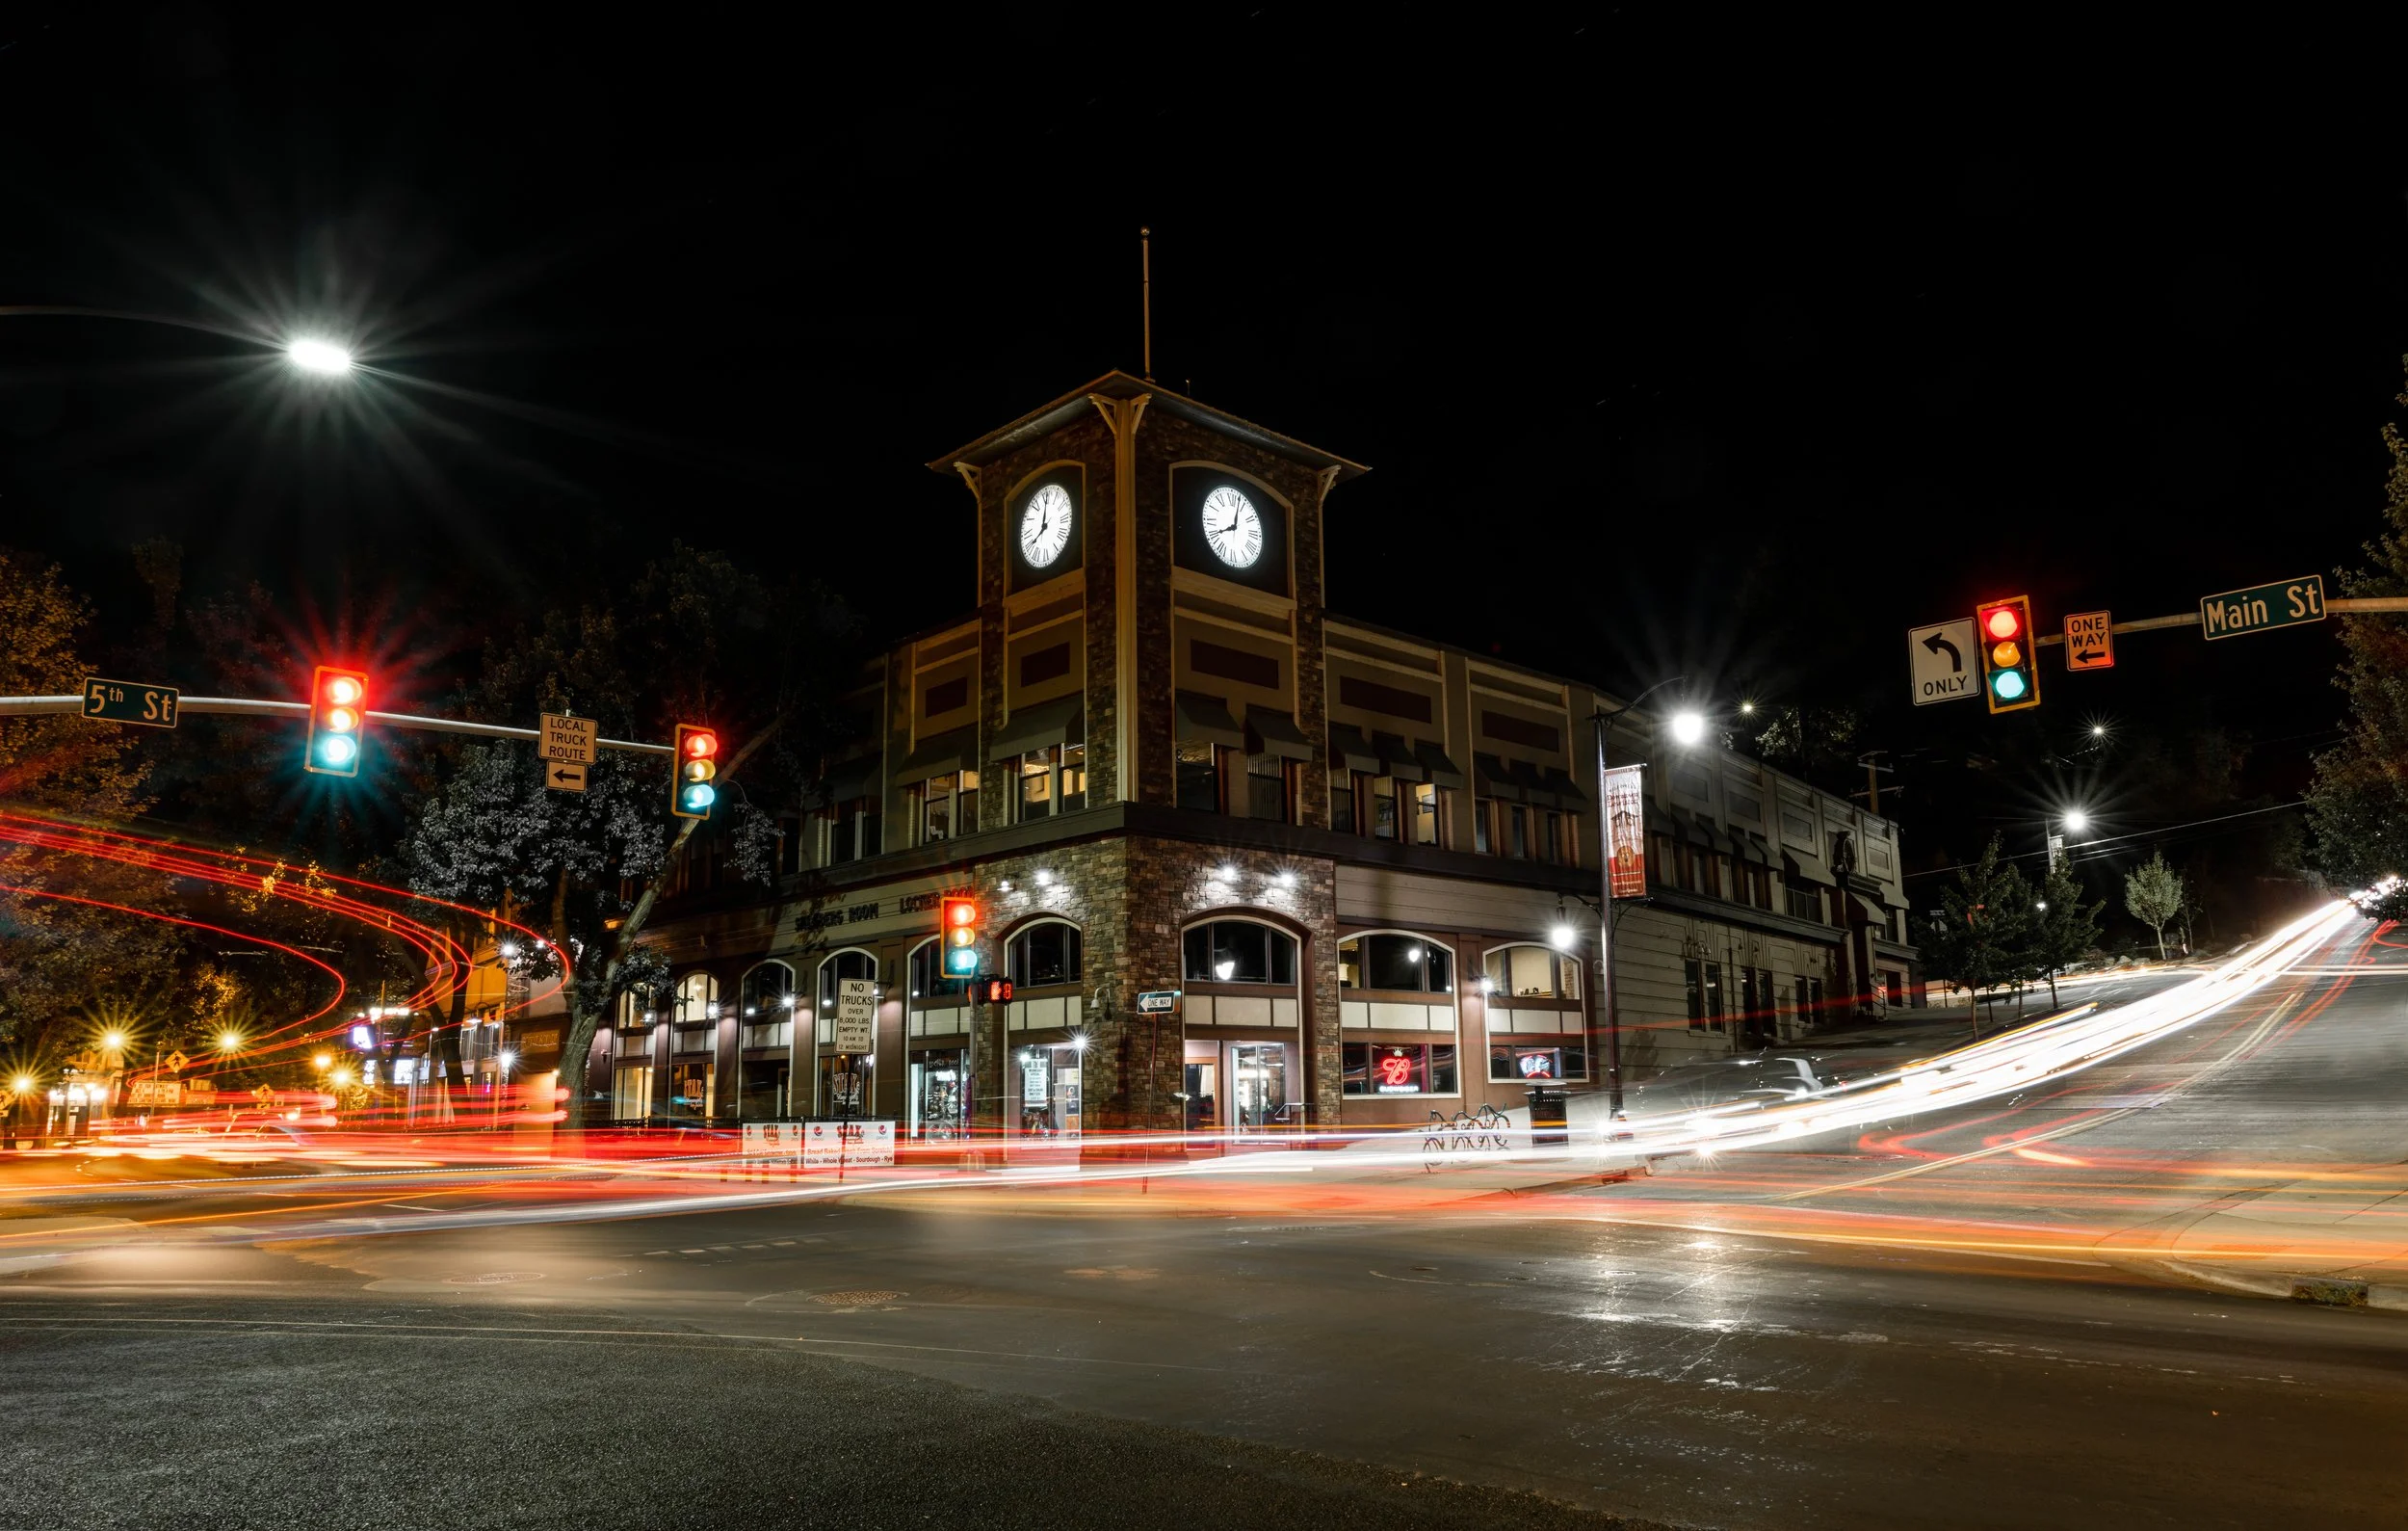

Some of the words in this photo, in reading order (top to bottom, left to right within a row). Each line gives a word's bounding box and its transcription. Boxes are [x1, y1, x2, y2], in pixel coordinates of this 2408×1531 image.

[2207, 595, 2268, 634] Main
[2287, 584, 2320, 619] St
[2071, 616, 2105, 634] ONE
[2072, 631, 2107, 649] WAY
[1924, 674, 1967, 696] ONLY
[89, 685, 123, 713] 5th
[144, 691, 172, 722] St
[550, 717, 588, 732] LOCAL
[550, 731, 588, 747] TRUCK
[549, 746, 586, 760] ROUTE
[849, 902, 878, 923] ROOM
[851, 983, 864, 992] NO
[841, 994, 873, 1006] TRUCKS
[1148, 998, 1159, 1008] ONE
[1160, 998, 1170, 1007] WAY
[856, 1155, 880, 1164] Sourdough
